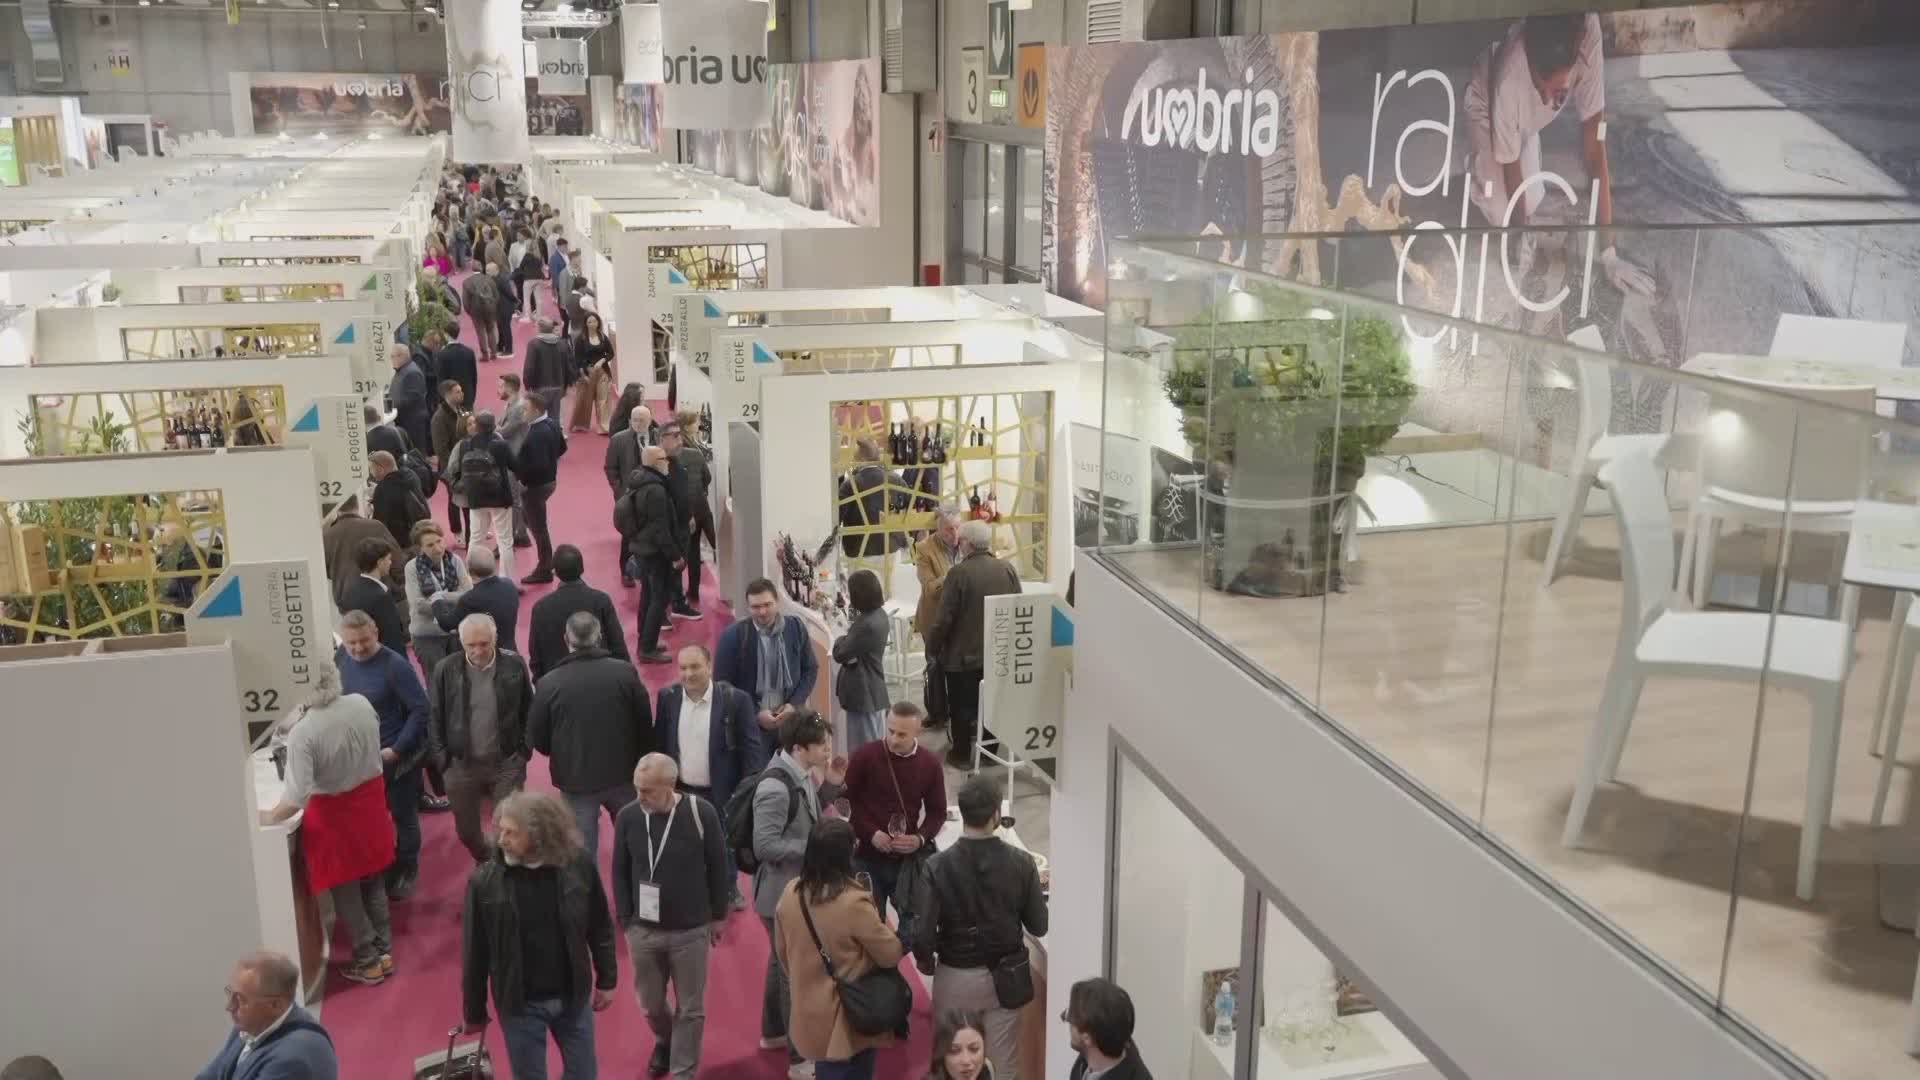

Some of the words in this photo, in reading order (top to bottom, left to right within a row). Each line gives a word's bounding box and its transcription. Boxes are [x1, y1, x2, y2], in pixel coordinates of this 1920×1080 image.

[334, 79, 404, 97] umbria
[968, 70, 977, 115] 3
[1138, 67, 1280, 157] umbria
[1367, 69, 1456, 197] ra
[373, 321, 384, 361] MEAZZI
[696, 352, 709, 363] 27
[735, 341, 745, 382] ETICHE
[742, 404, 759, 417] 29
[346, 401, 360, 461] POGGETTE
[320, 481, 342, 496] 32
[352, 465, 362, 479] LE
[283, 571, 306, 658] POGGETTE
[995, 607, 1009, 678] CANTINE
[1015, 605, 1034, 685] ETICHE
[293, 663, 310, 685] LE
[244, 689, 280, 712] 32
[1025, 725, 1057, 750] 29
